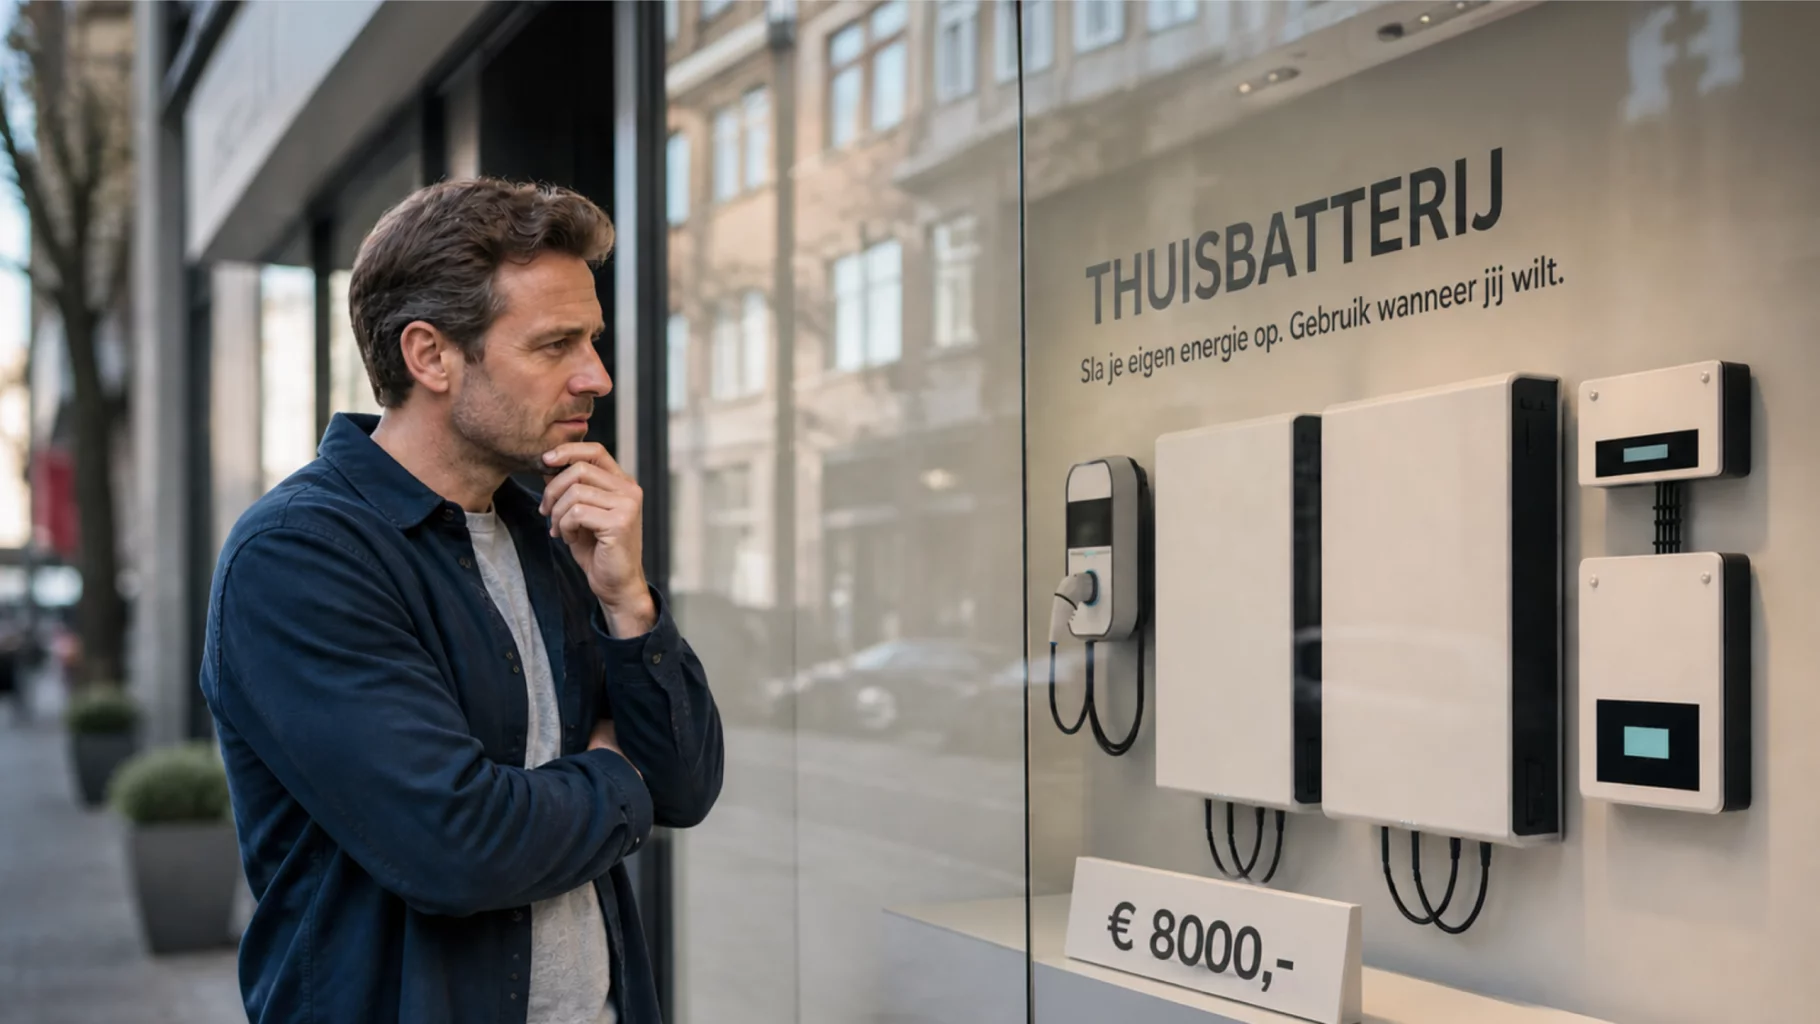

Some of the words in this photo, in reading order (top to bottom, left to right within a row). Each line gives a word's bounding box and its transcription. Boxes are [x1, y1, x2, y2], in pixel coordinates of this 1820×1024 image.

[1085, 147, 1503, 325] THUISBATTERIJ
[1080, 356, 1104, 384] Sla
[1108, 352, 1123, 385] je
[1128, 346, 1175, 378] eigen
[1180, 325, 1248, 362] energie
[1254, 324, 1284, 353] op.
[1290, 296, 1371, 340] Gebruik
[1377, 278, 1477, 321] wanneer
[1483, 265, 1504, 309] jij
[1511, 255, 1565, 293] wilt.
[1107, 901, 1136, 951] €
[1150, 908, 1294, 992] 8000,-
